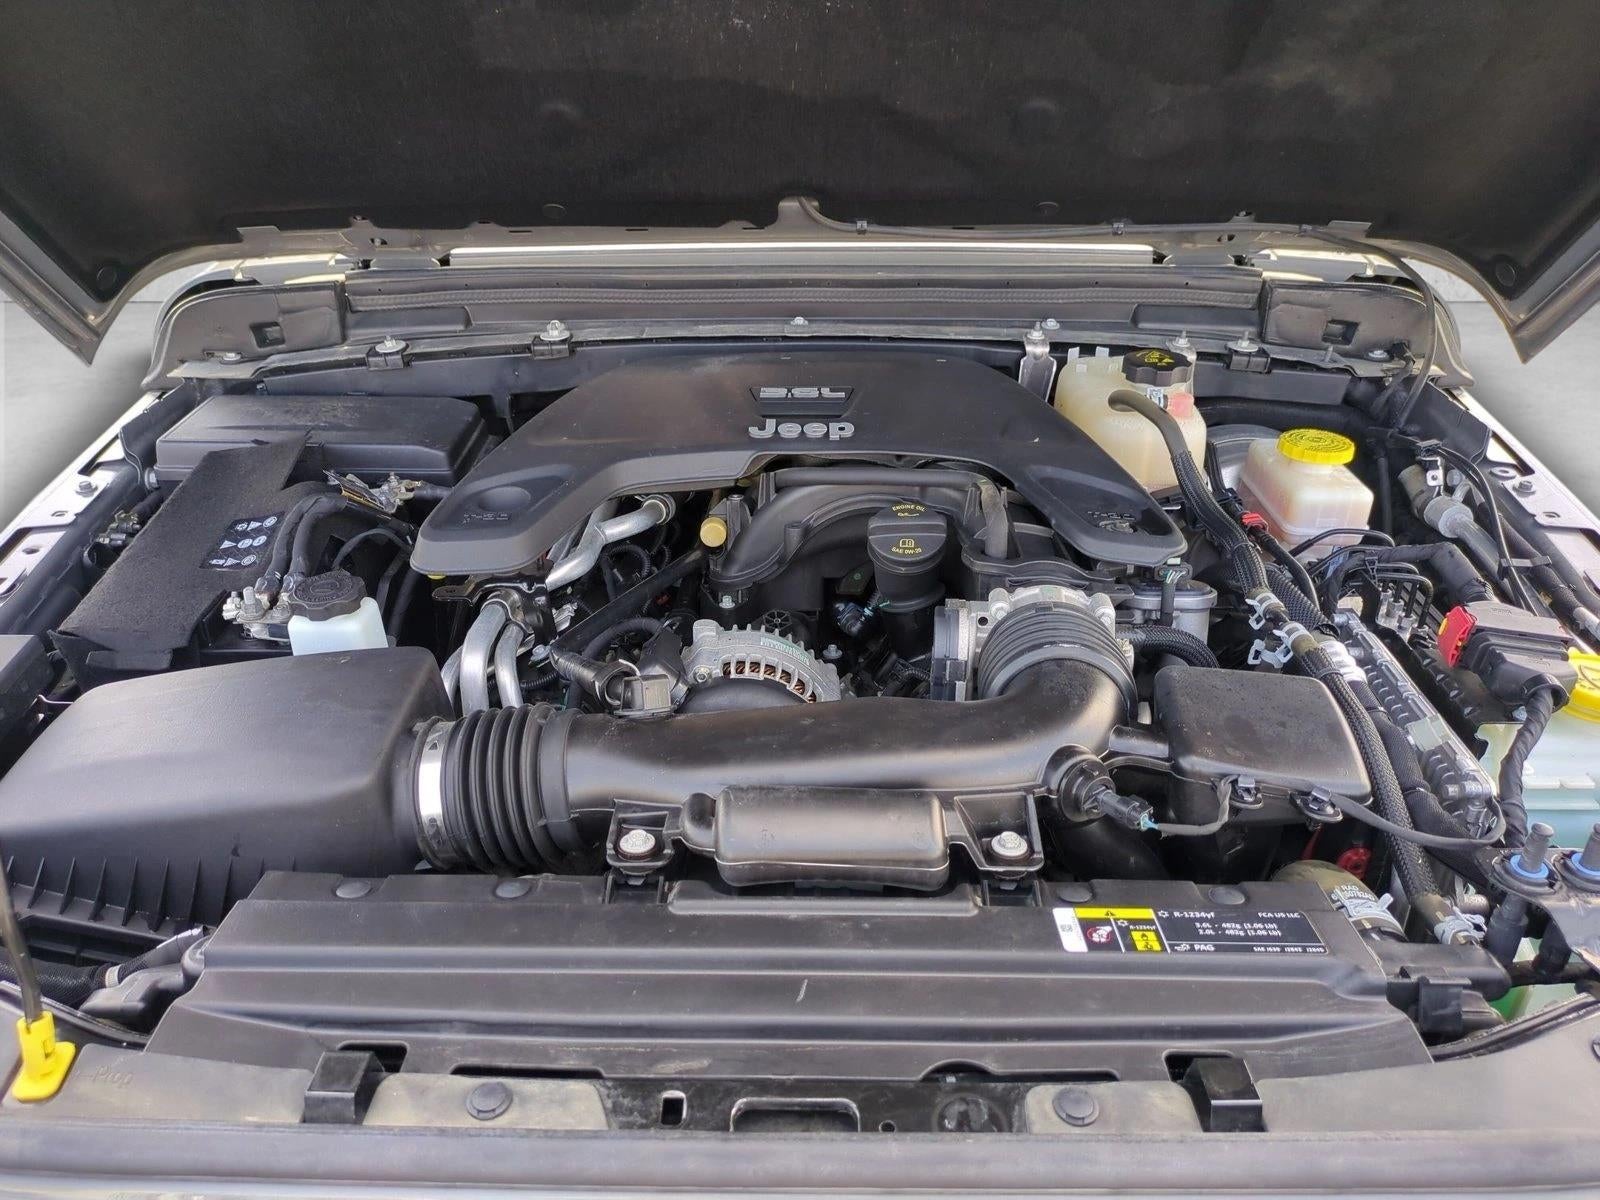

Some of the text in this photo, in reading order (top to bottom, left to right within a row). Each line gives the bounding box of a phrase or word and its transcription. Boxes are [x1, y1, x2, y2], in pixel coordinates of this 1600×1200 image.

[748, 418, 855, 441] Jeep
[891, 546, 904, 554] SAE
[1257, 911, 1274, 919] FCA
[1193, 943, 1216, 952] PAG
